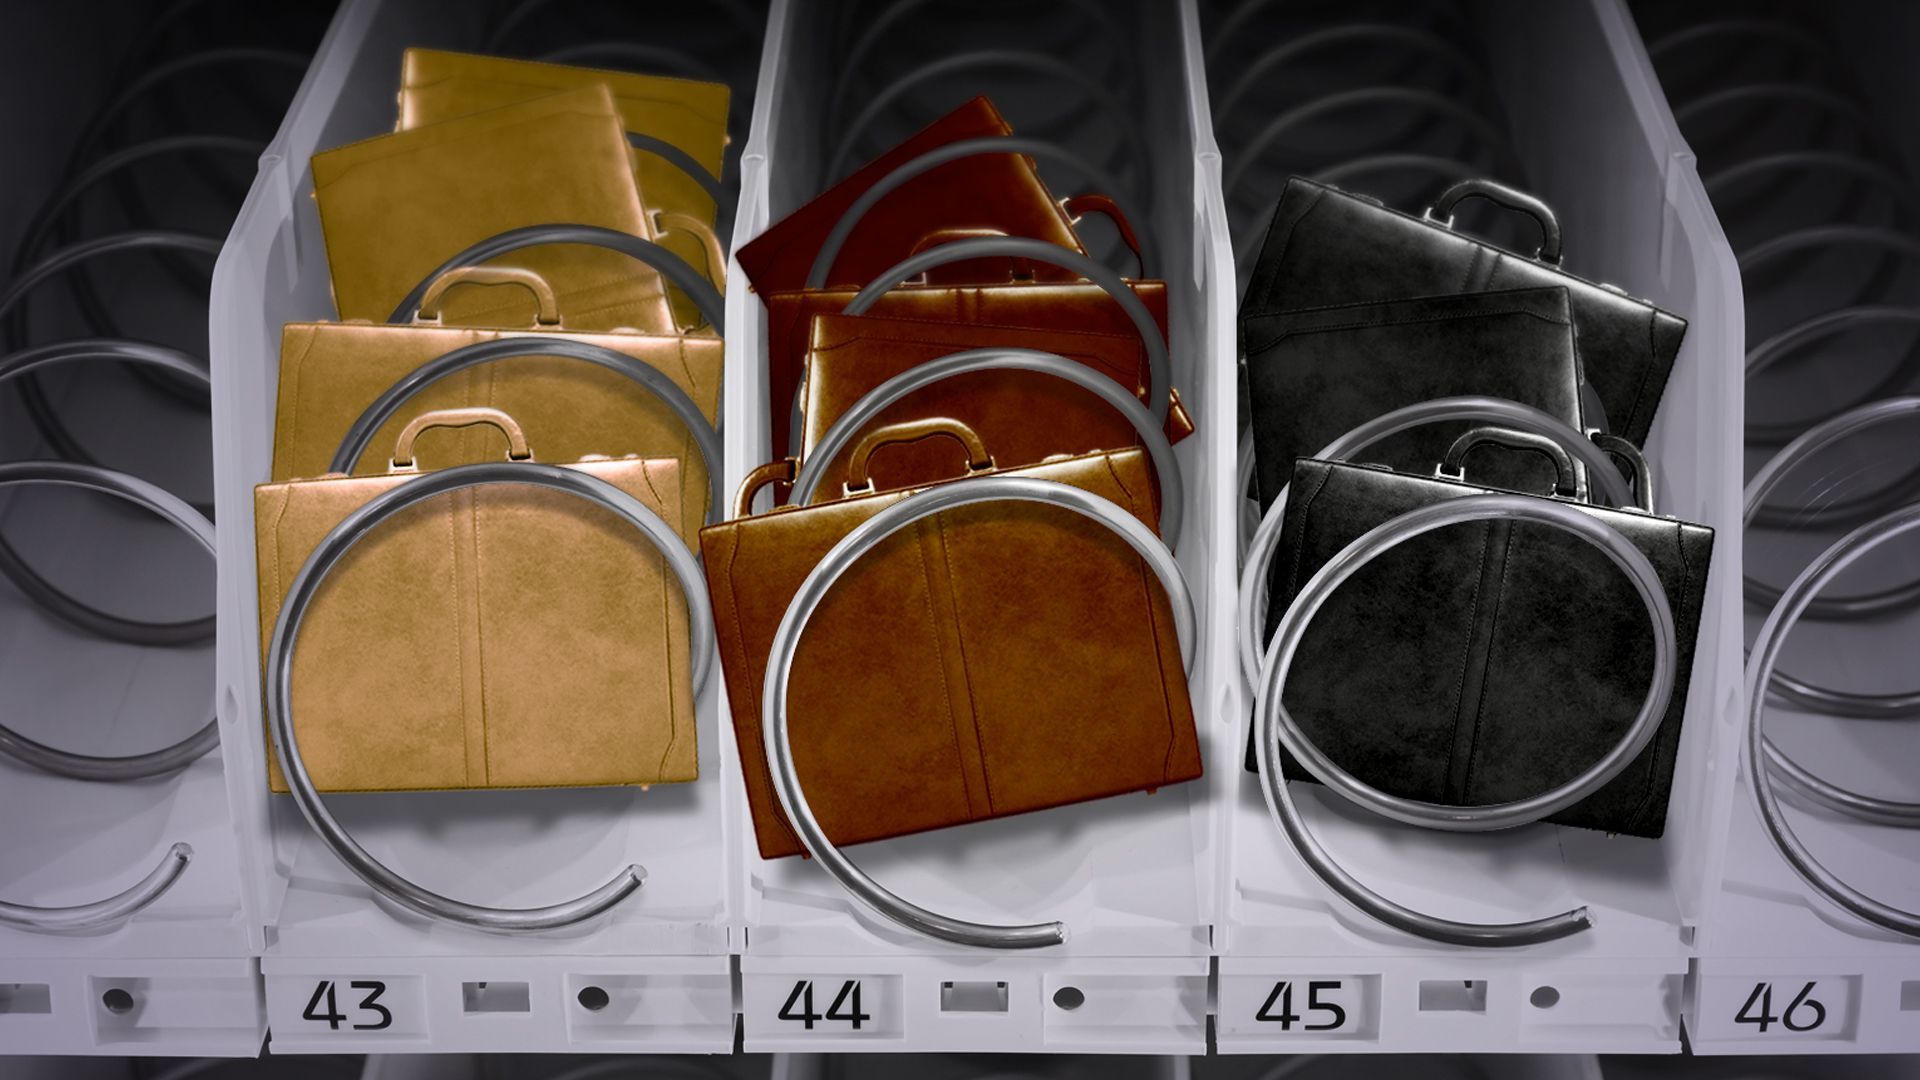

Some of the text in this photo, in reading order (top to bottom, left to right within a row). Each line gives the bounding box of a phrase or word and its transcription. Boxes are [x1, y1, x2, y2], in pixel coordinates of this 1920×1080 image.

[302, 980, 393, 1031] 43
[777, 980, 871, 1030] 44
[1255, 980, 1346, 1031] 45
[1734, 981, 1826, 1033] 46
